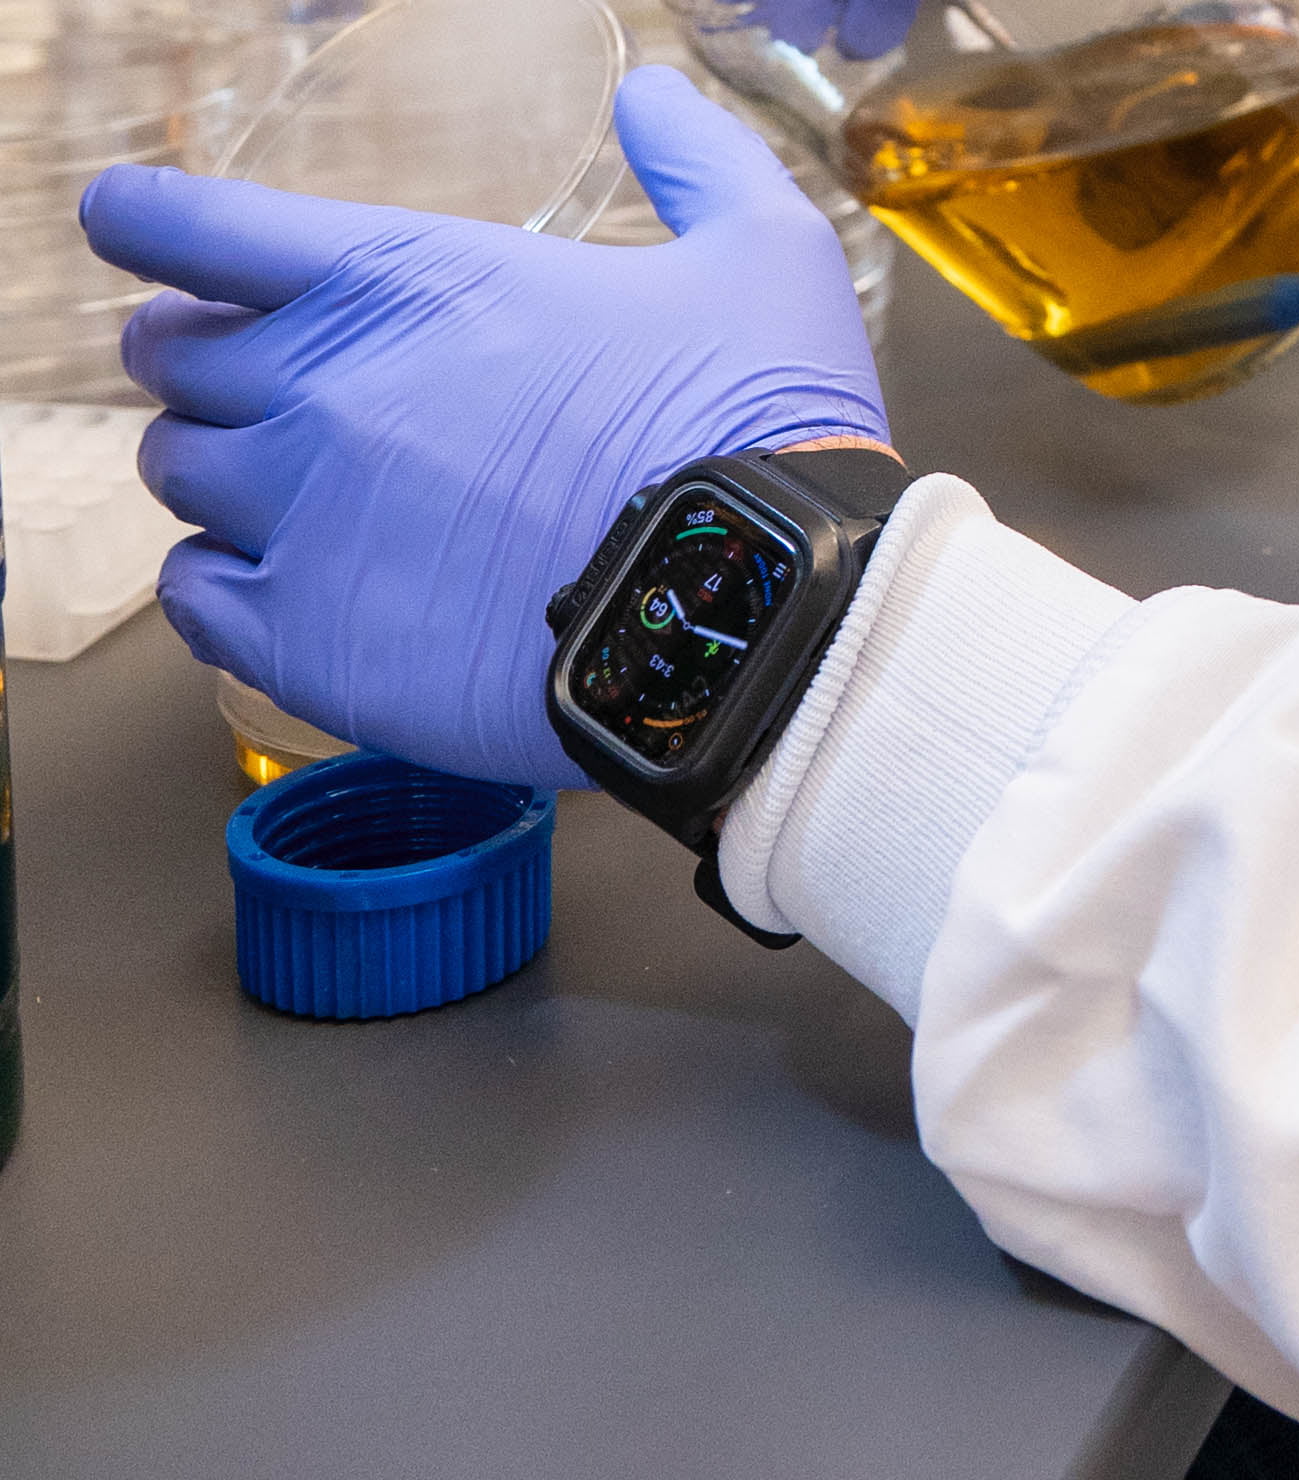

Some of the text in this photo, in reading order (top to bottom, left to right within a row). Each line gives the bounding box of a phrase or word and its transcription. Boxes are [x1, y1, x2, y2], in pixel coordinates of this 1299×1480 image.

[686, 509, 715, 527] 85%
[703, 573, 723, 592] 17
[649, 597, 668, 617] 64
[649, 653, 675, 678] 3:43
